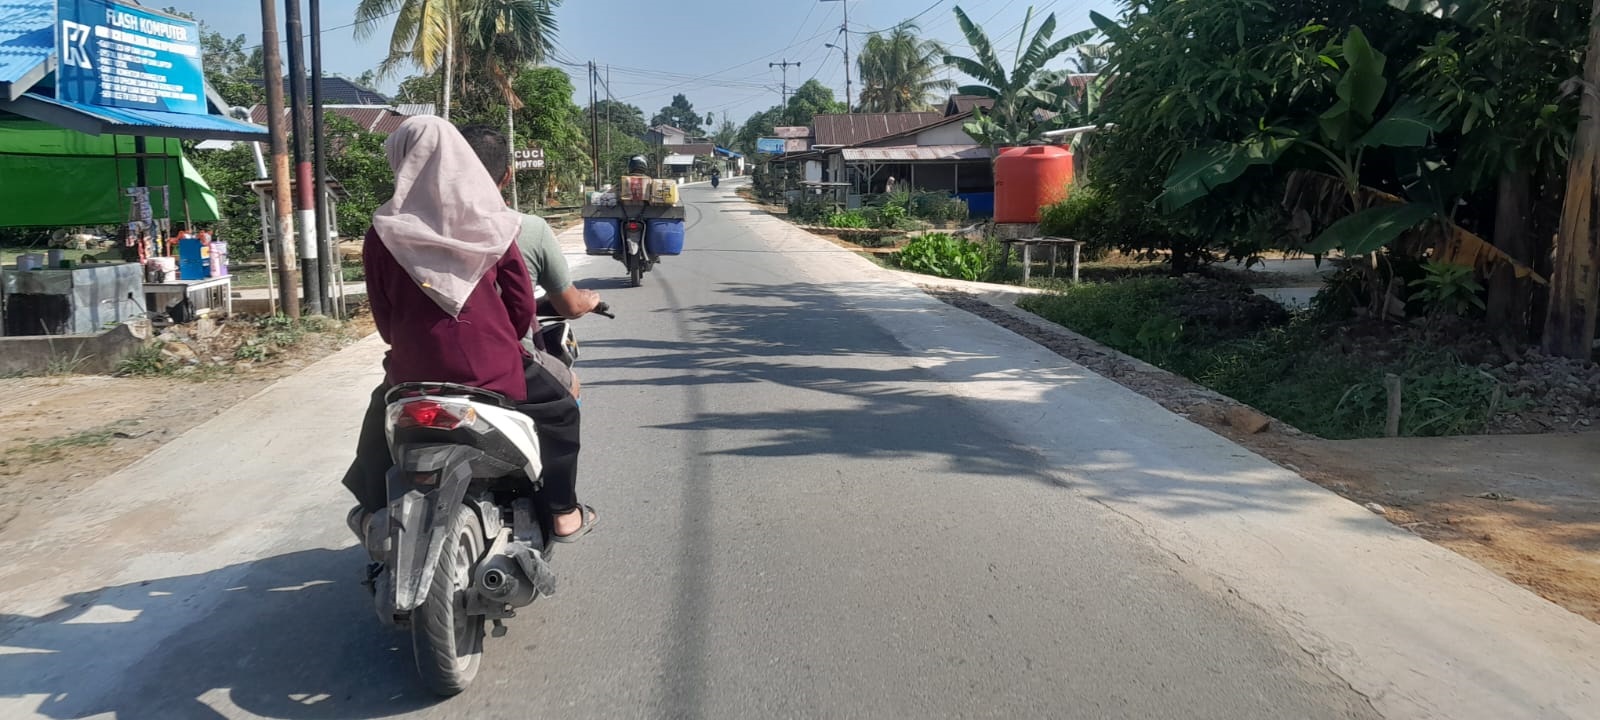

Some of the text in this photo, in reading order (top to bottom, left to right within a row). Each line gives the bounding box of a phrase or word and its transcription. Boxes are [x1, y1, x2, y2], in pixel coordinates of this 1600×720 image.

[105, 8, 138, 31] FLASH
[139, 17, 188, 41] KOMPUTER
[514, 149, 544, 159] CUCI
[515, 159, 545, 169] MOTOR
